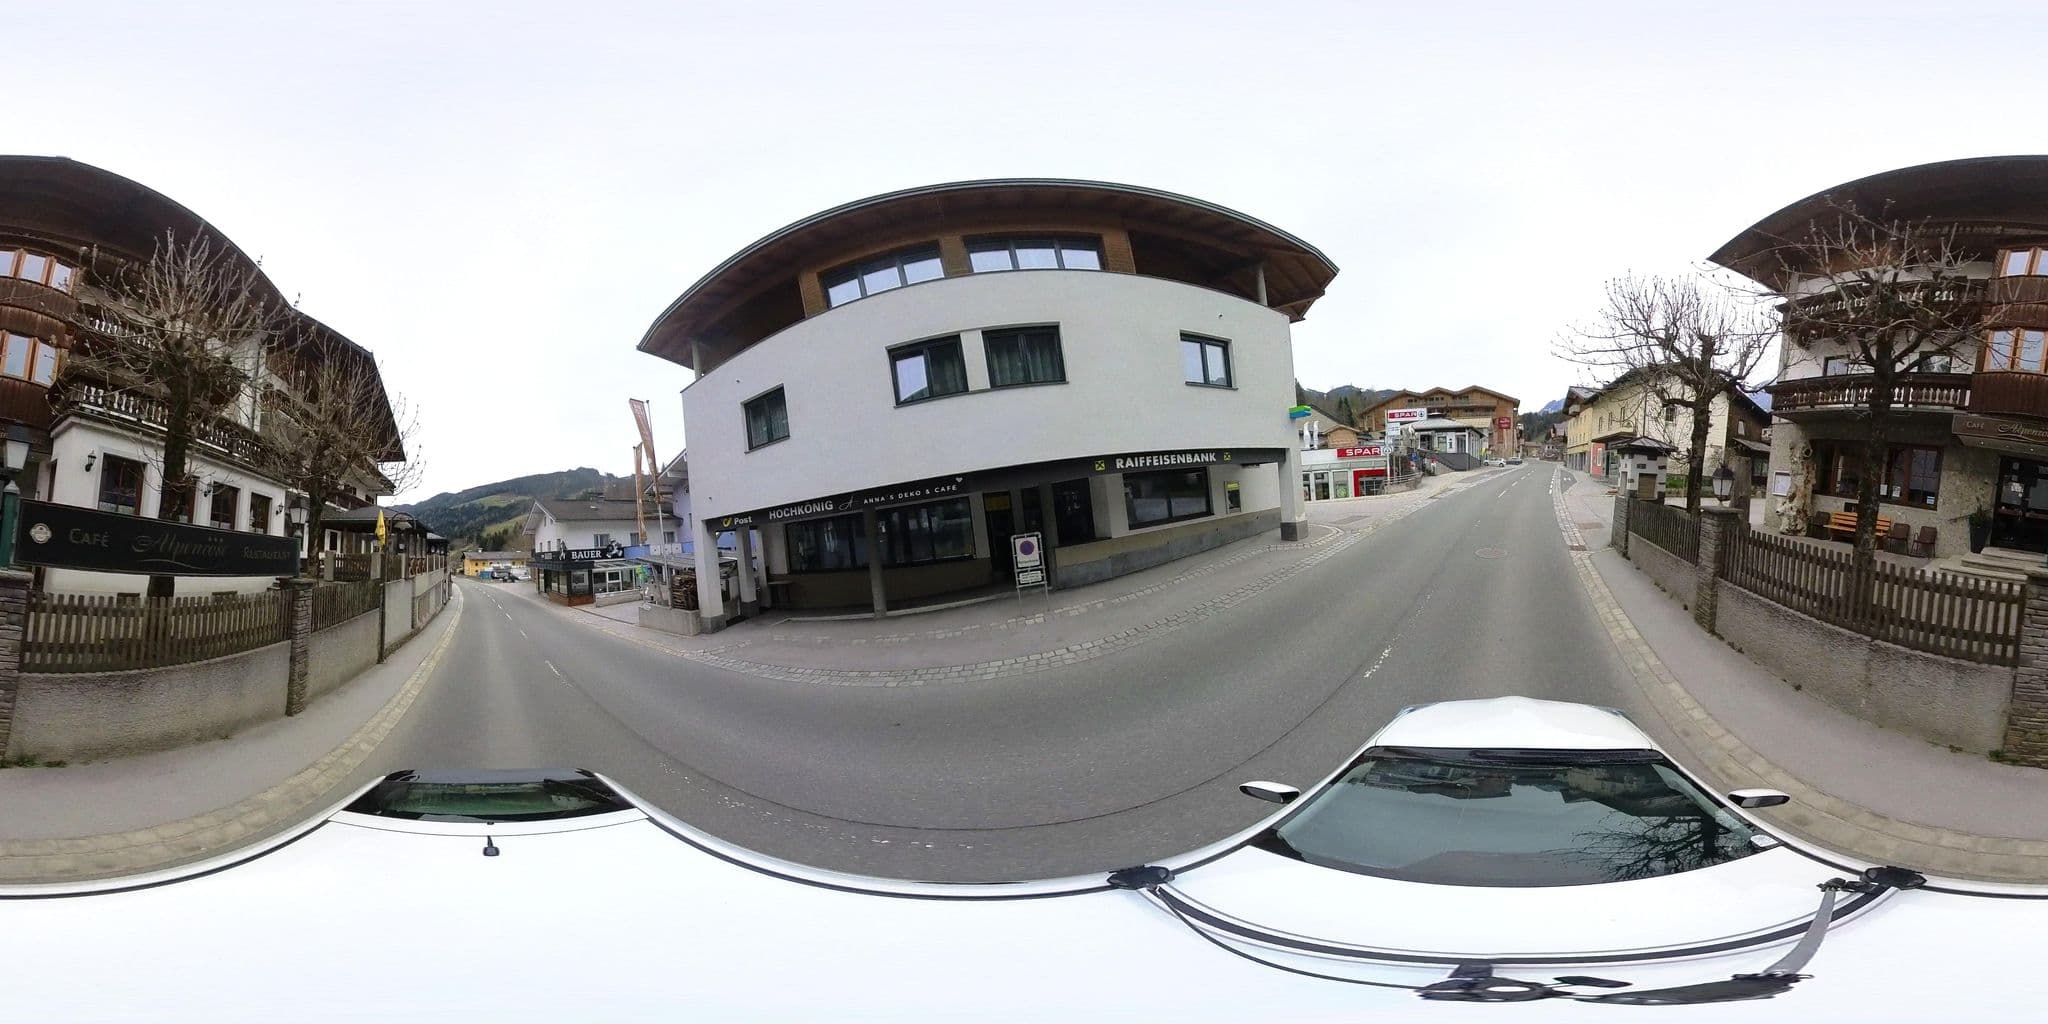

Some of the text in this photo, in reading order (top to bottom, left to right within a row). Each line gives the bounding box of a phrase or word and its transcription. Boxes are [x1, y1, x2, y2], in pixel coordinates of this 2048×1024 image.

[1345, 447, 1380, 456] SPAR
[1115, 452, 1217, 469] RAIFFEISENBANK
[897, 490, 921, 500] DEKO
[734, 515, 753, 525] Post
[571, 550, 602, 560] BAUER
